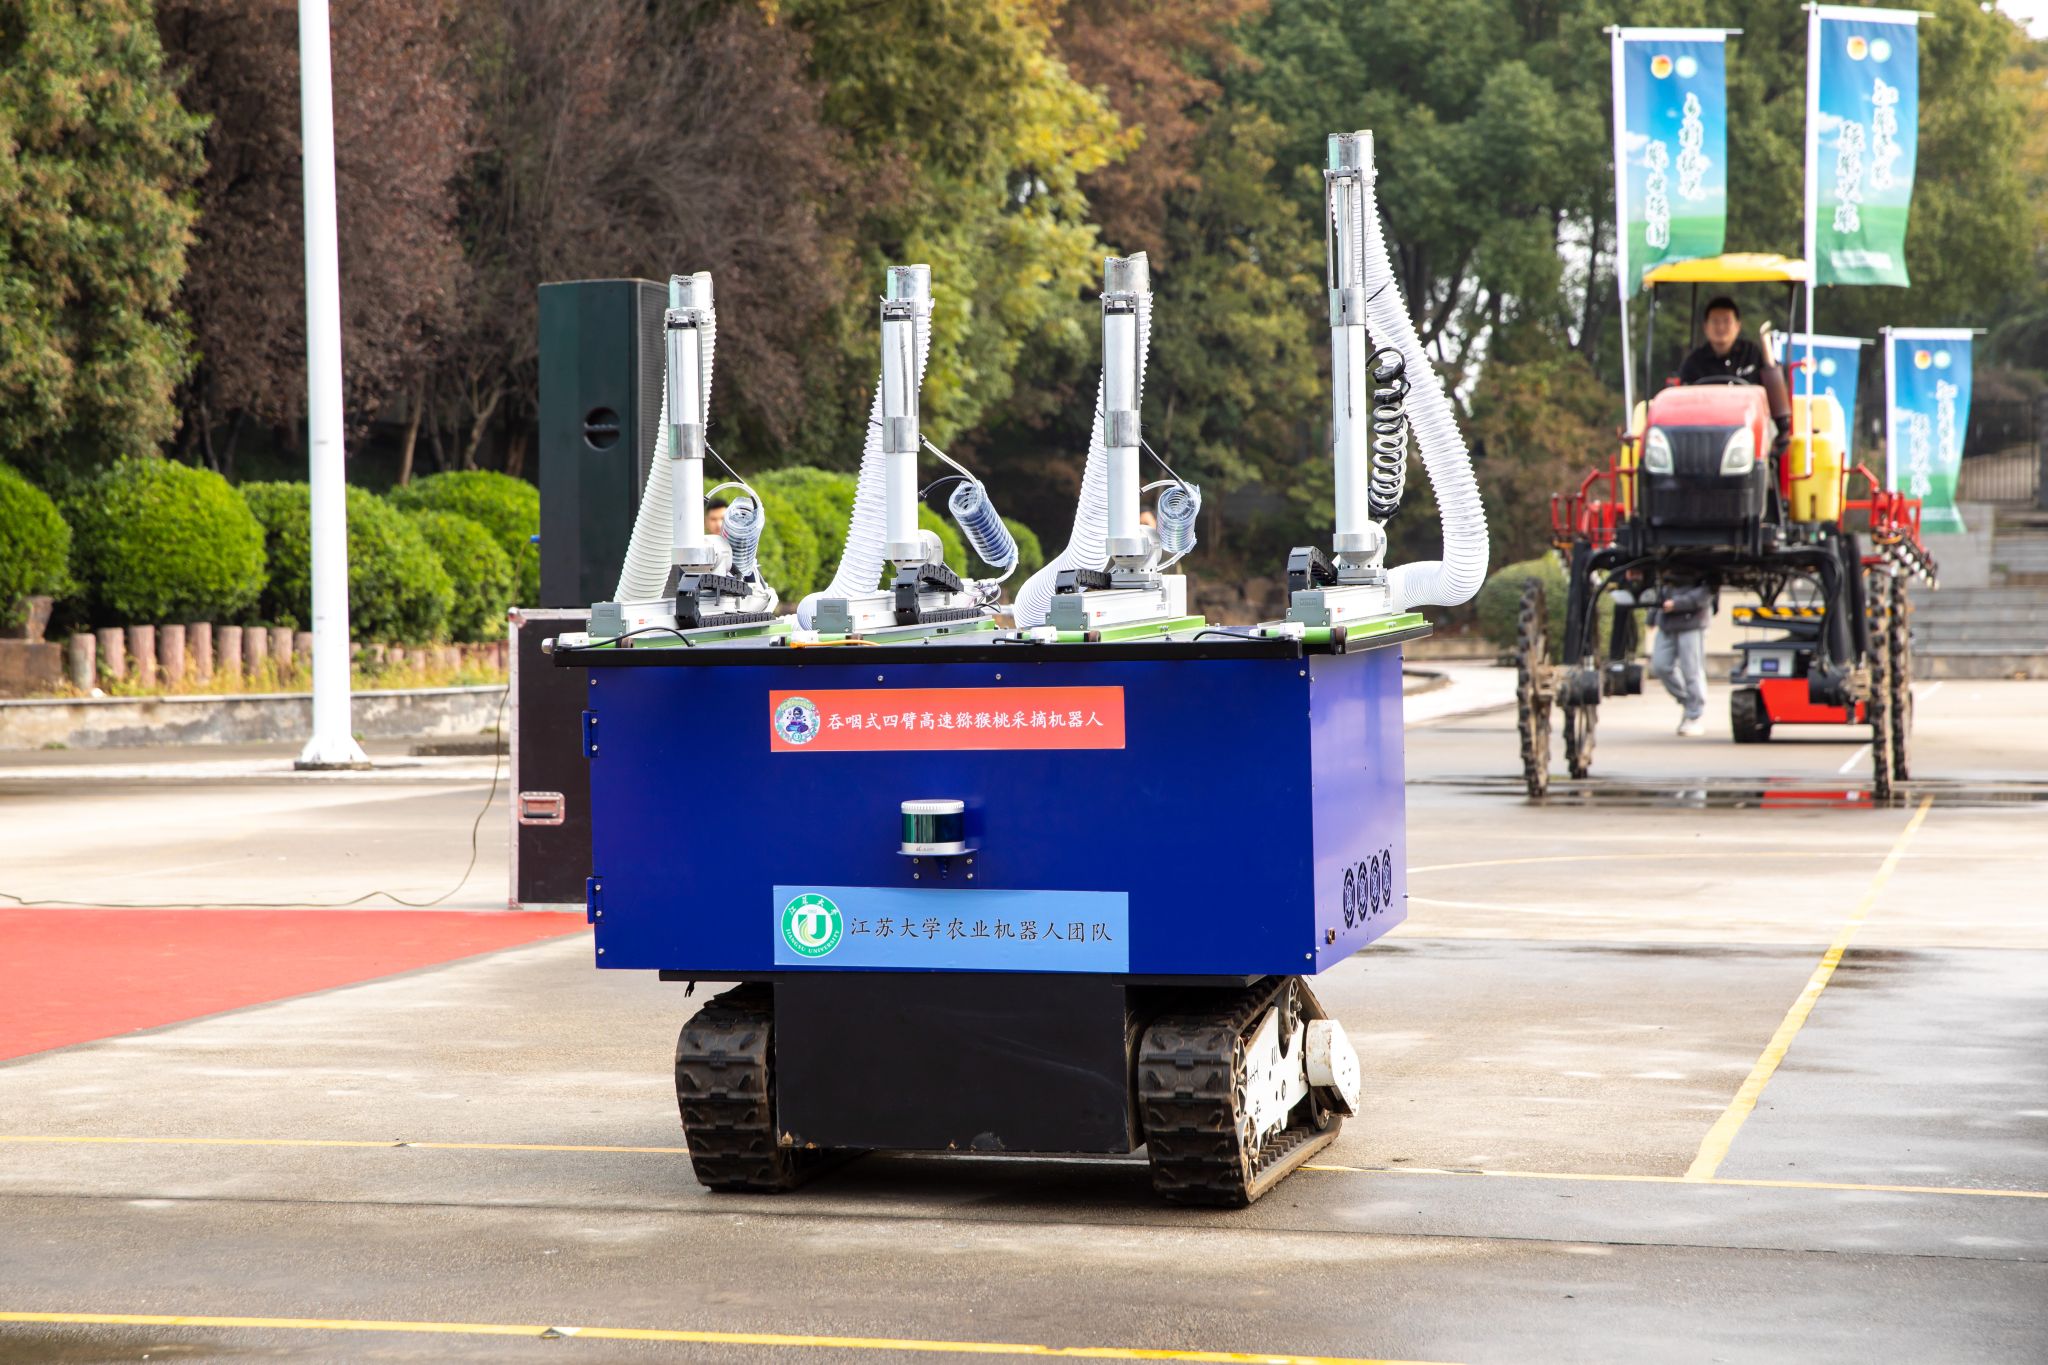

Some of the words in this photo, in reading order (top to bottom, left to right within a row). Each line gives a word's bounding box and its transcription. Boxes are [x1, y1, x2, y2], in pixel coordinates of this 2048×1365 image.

[827, 710, 1104, 731] 吞咽式四臂高速猕猴桃采摘机器人
[808, 929, 841, 954] UNIVERSITY
[850, 917, 1113, 943] 江苏大学农业机器人团队
